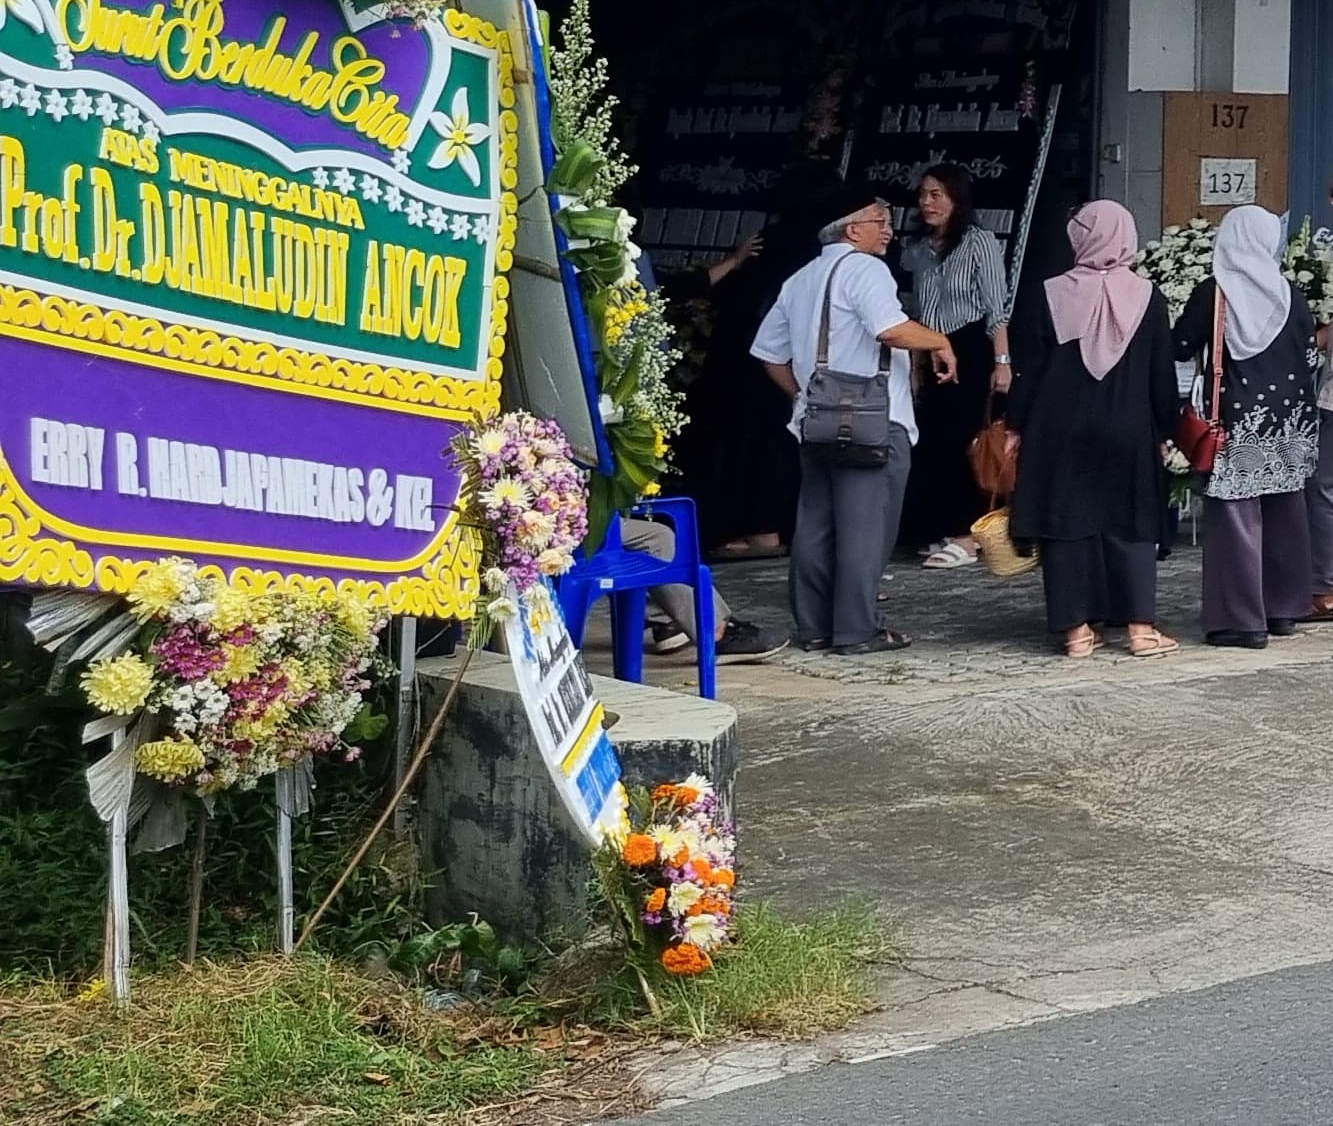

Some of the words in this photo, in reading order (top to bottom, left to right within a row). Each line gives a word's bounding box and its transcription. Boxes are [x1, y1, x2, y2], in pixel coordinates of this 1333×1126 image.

[329, 36, 411, 150] Cita
[1211, 103, 1249, 129] 137
[101, 127, 160, 174] ATAS
[169, 148, 366, 230] MENINGGALNYA
[1208, 173, 1246, 194] 137
[359, 240, 467, 349] ANCOK
[31, 417, 104, 490] ERRY
[366, 468, 394, 527] &
